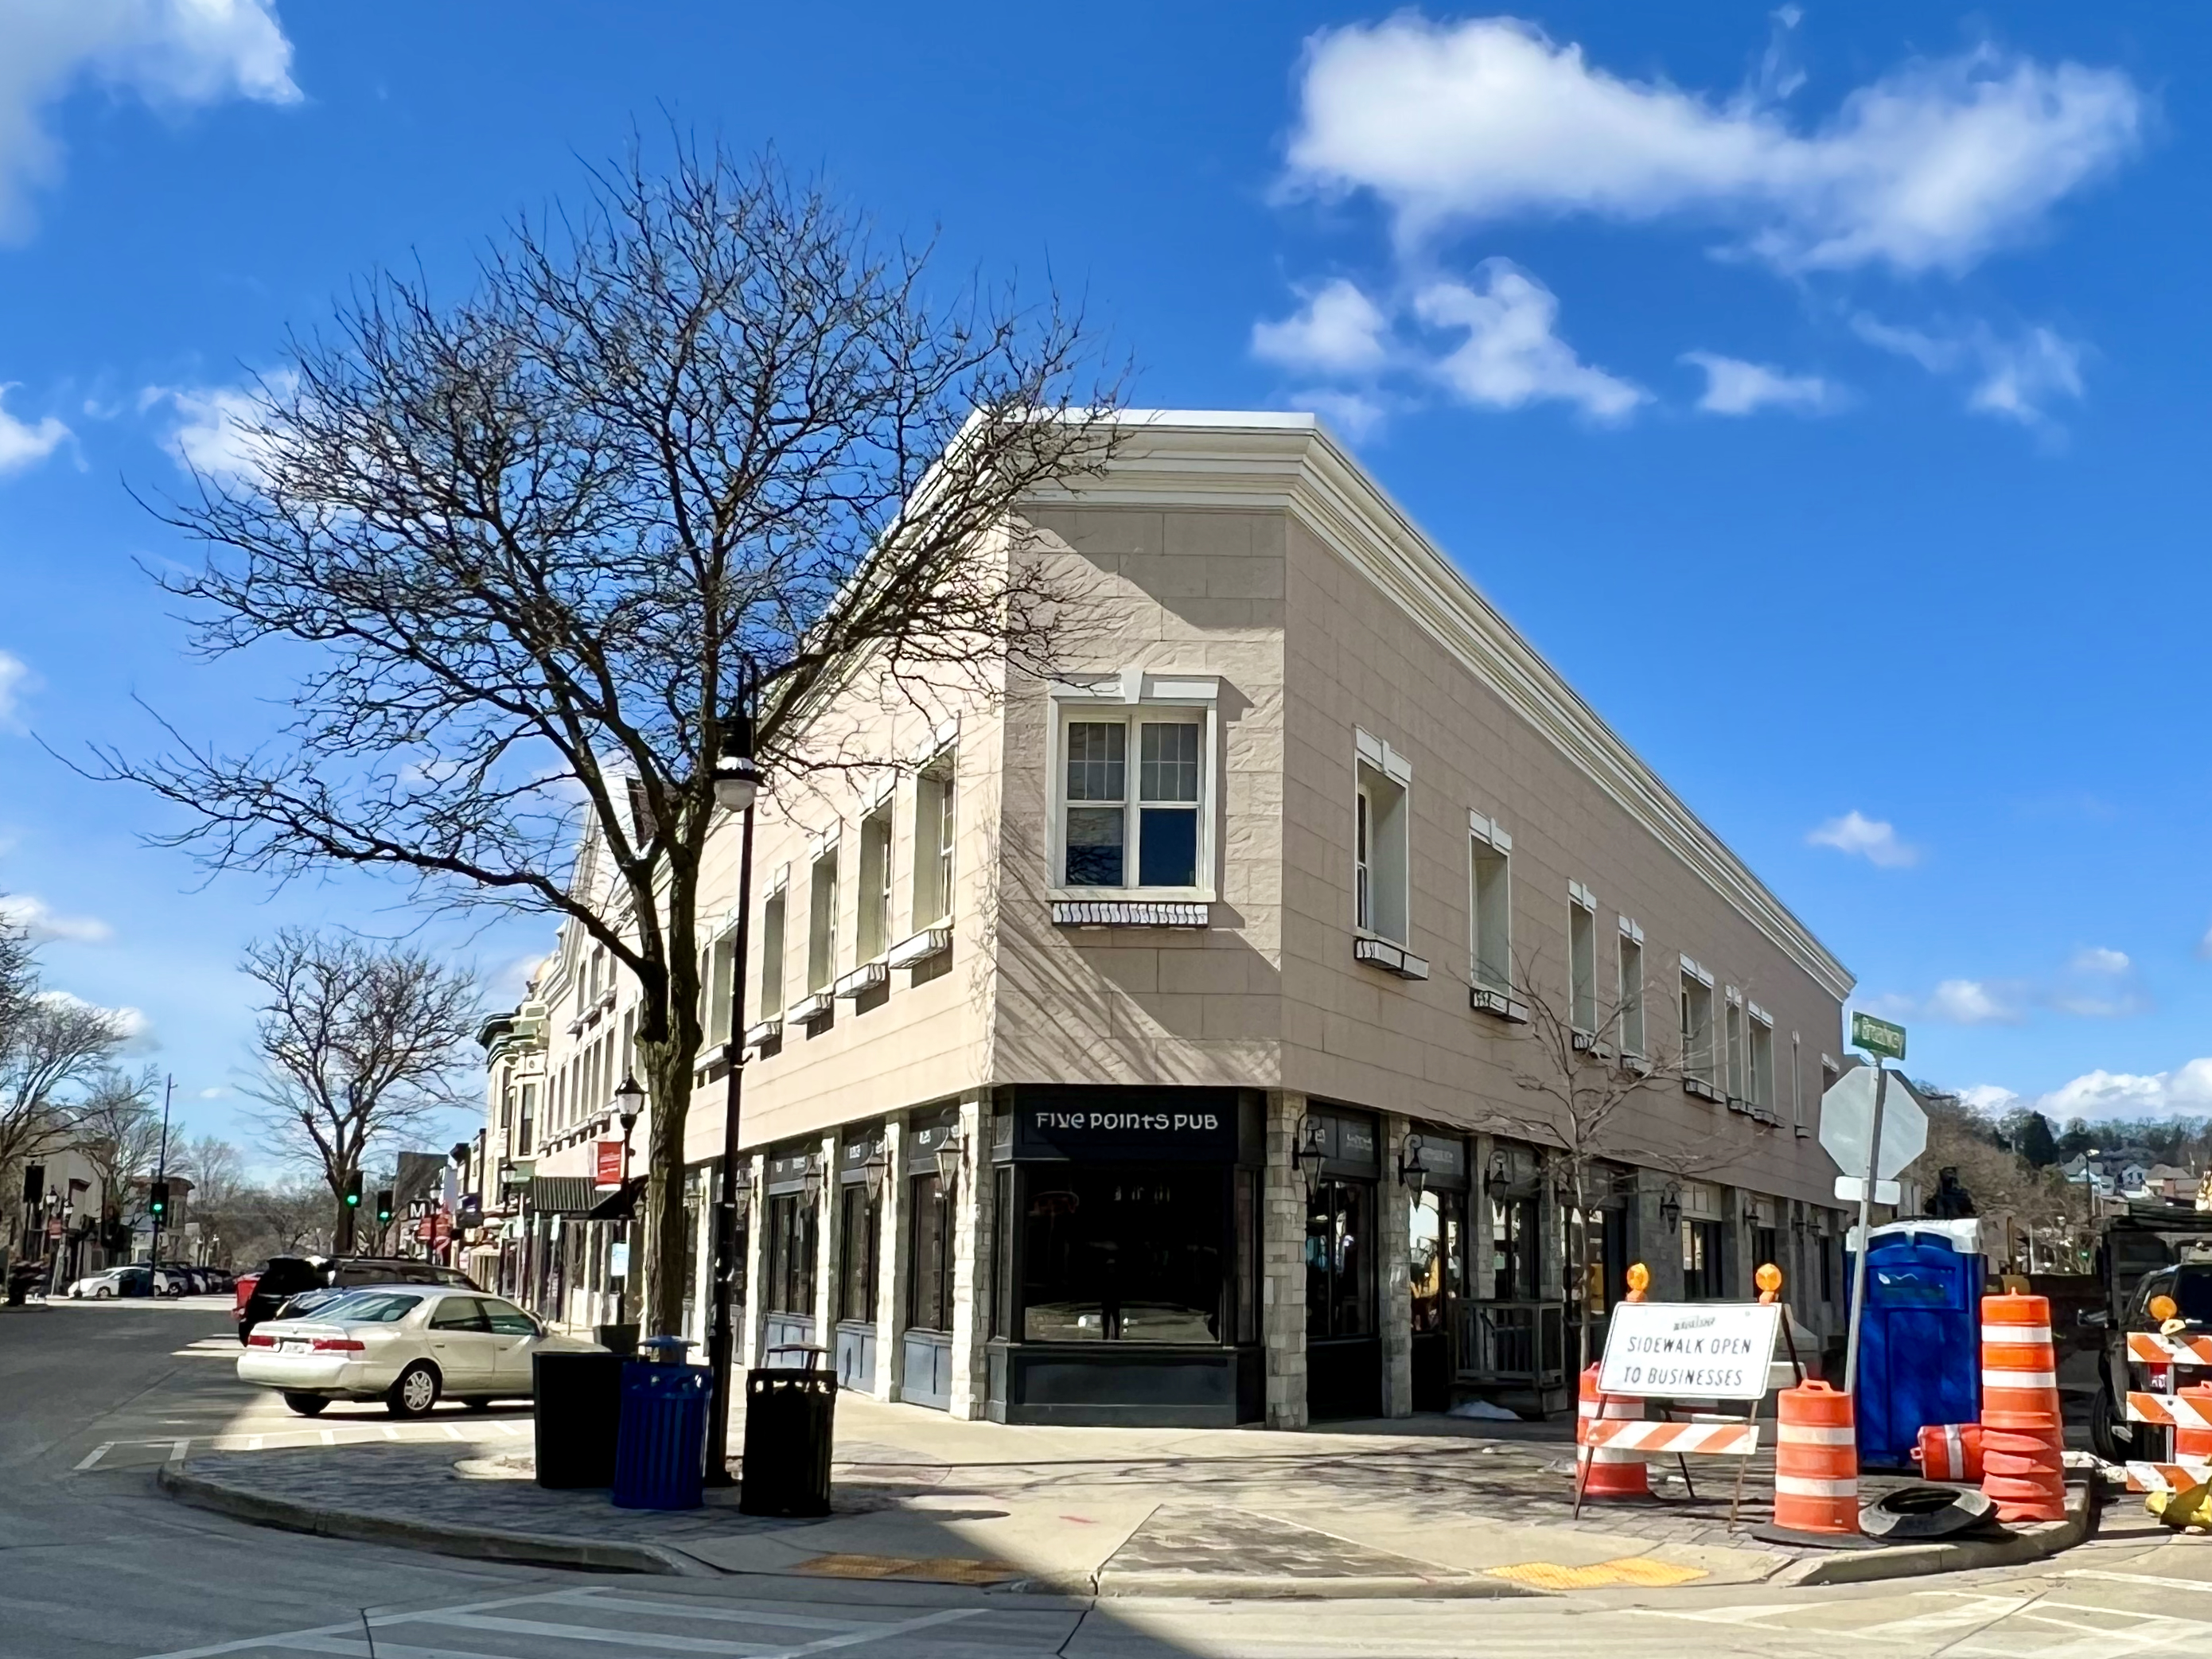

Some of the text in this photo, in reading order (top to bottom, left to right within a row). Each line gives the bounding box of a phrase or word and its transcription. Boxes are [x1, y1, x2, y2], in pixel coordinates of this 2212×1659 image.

[1174, 1114, 1218, 1131] PUB
[1627, 1337, 1751, 1354] SIDEWALK OPEN
[1624, 1366, 1743, 1386] TO BUSINESSES
